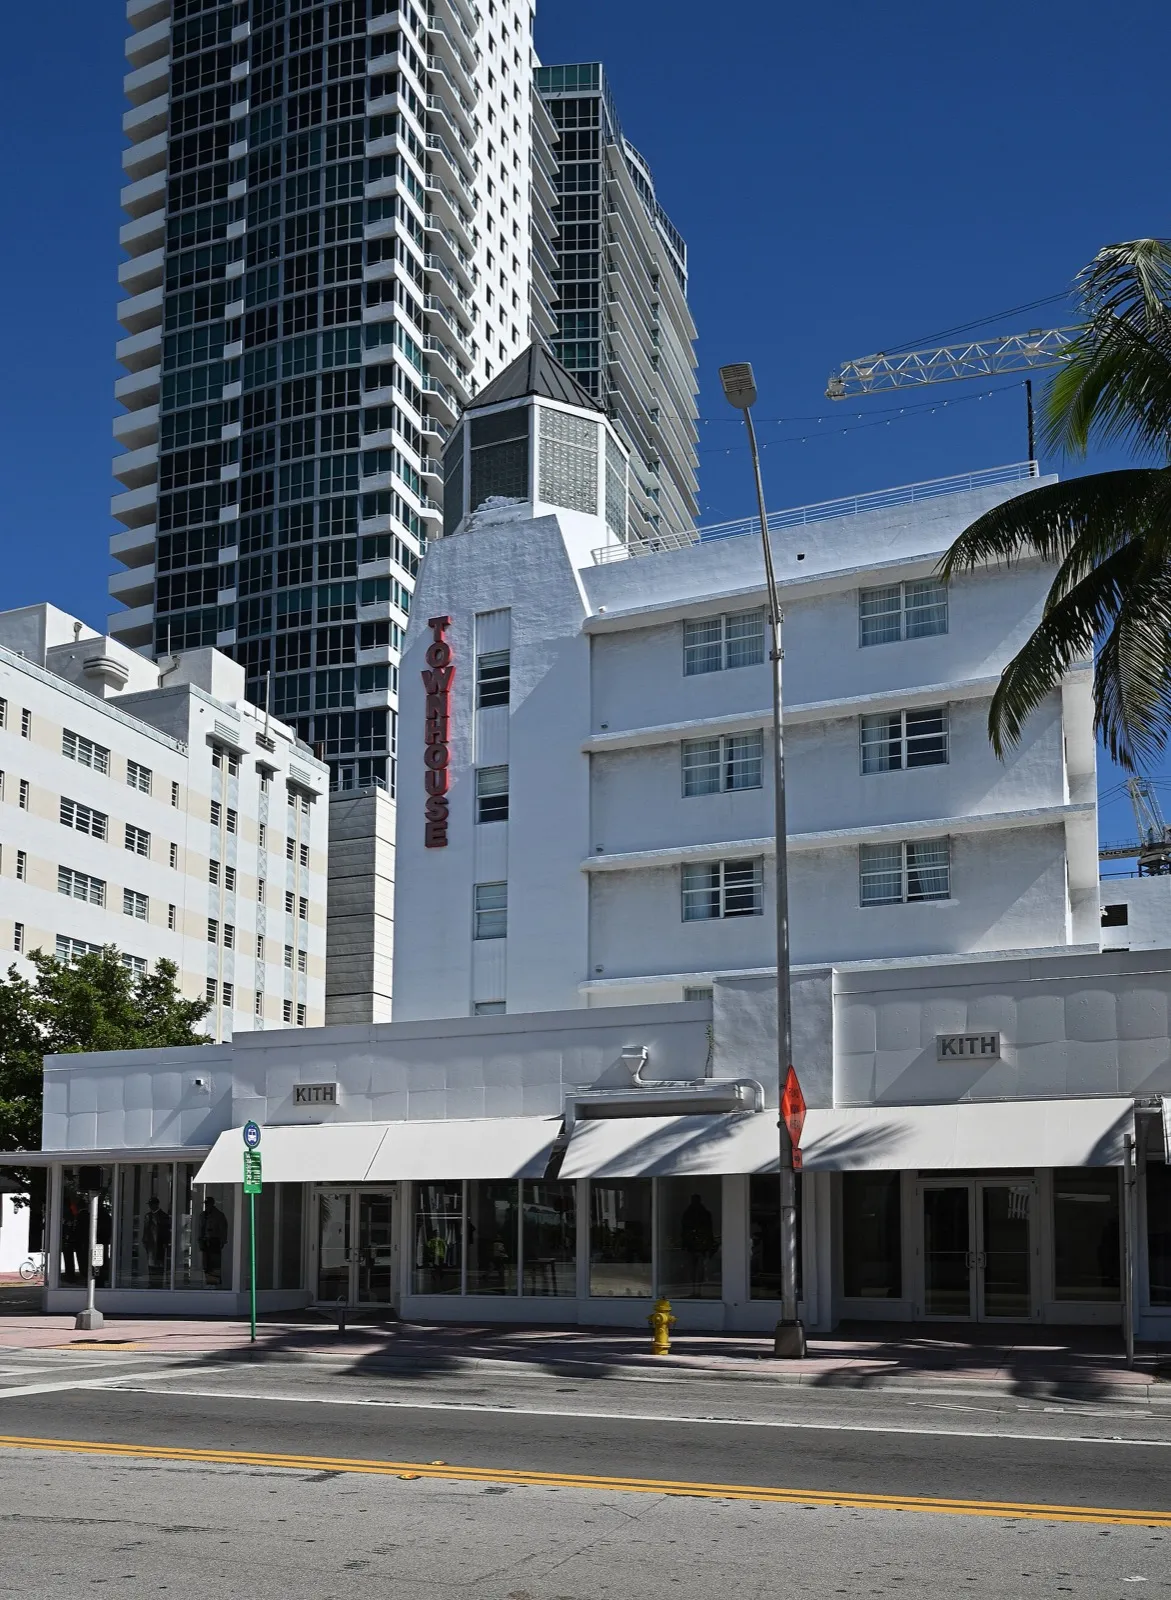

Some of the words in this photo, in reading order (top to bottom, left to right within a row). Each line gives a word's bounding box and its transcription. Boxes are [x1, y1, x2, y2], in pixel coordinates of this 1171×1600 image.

[421, 616, 454, 848] TOWNHOUSE
[942, 1037, 995, 1055] KITH
[296, 1086, 333, 1101] KITH
